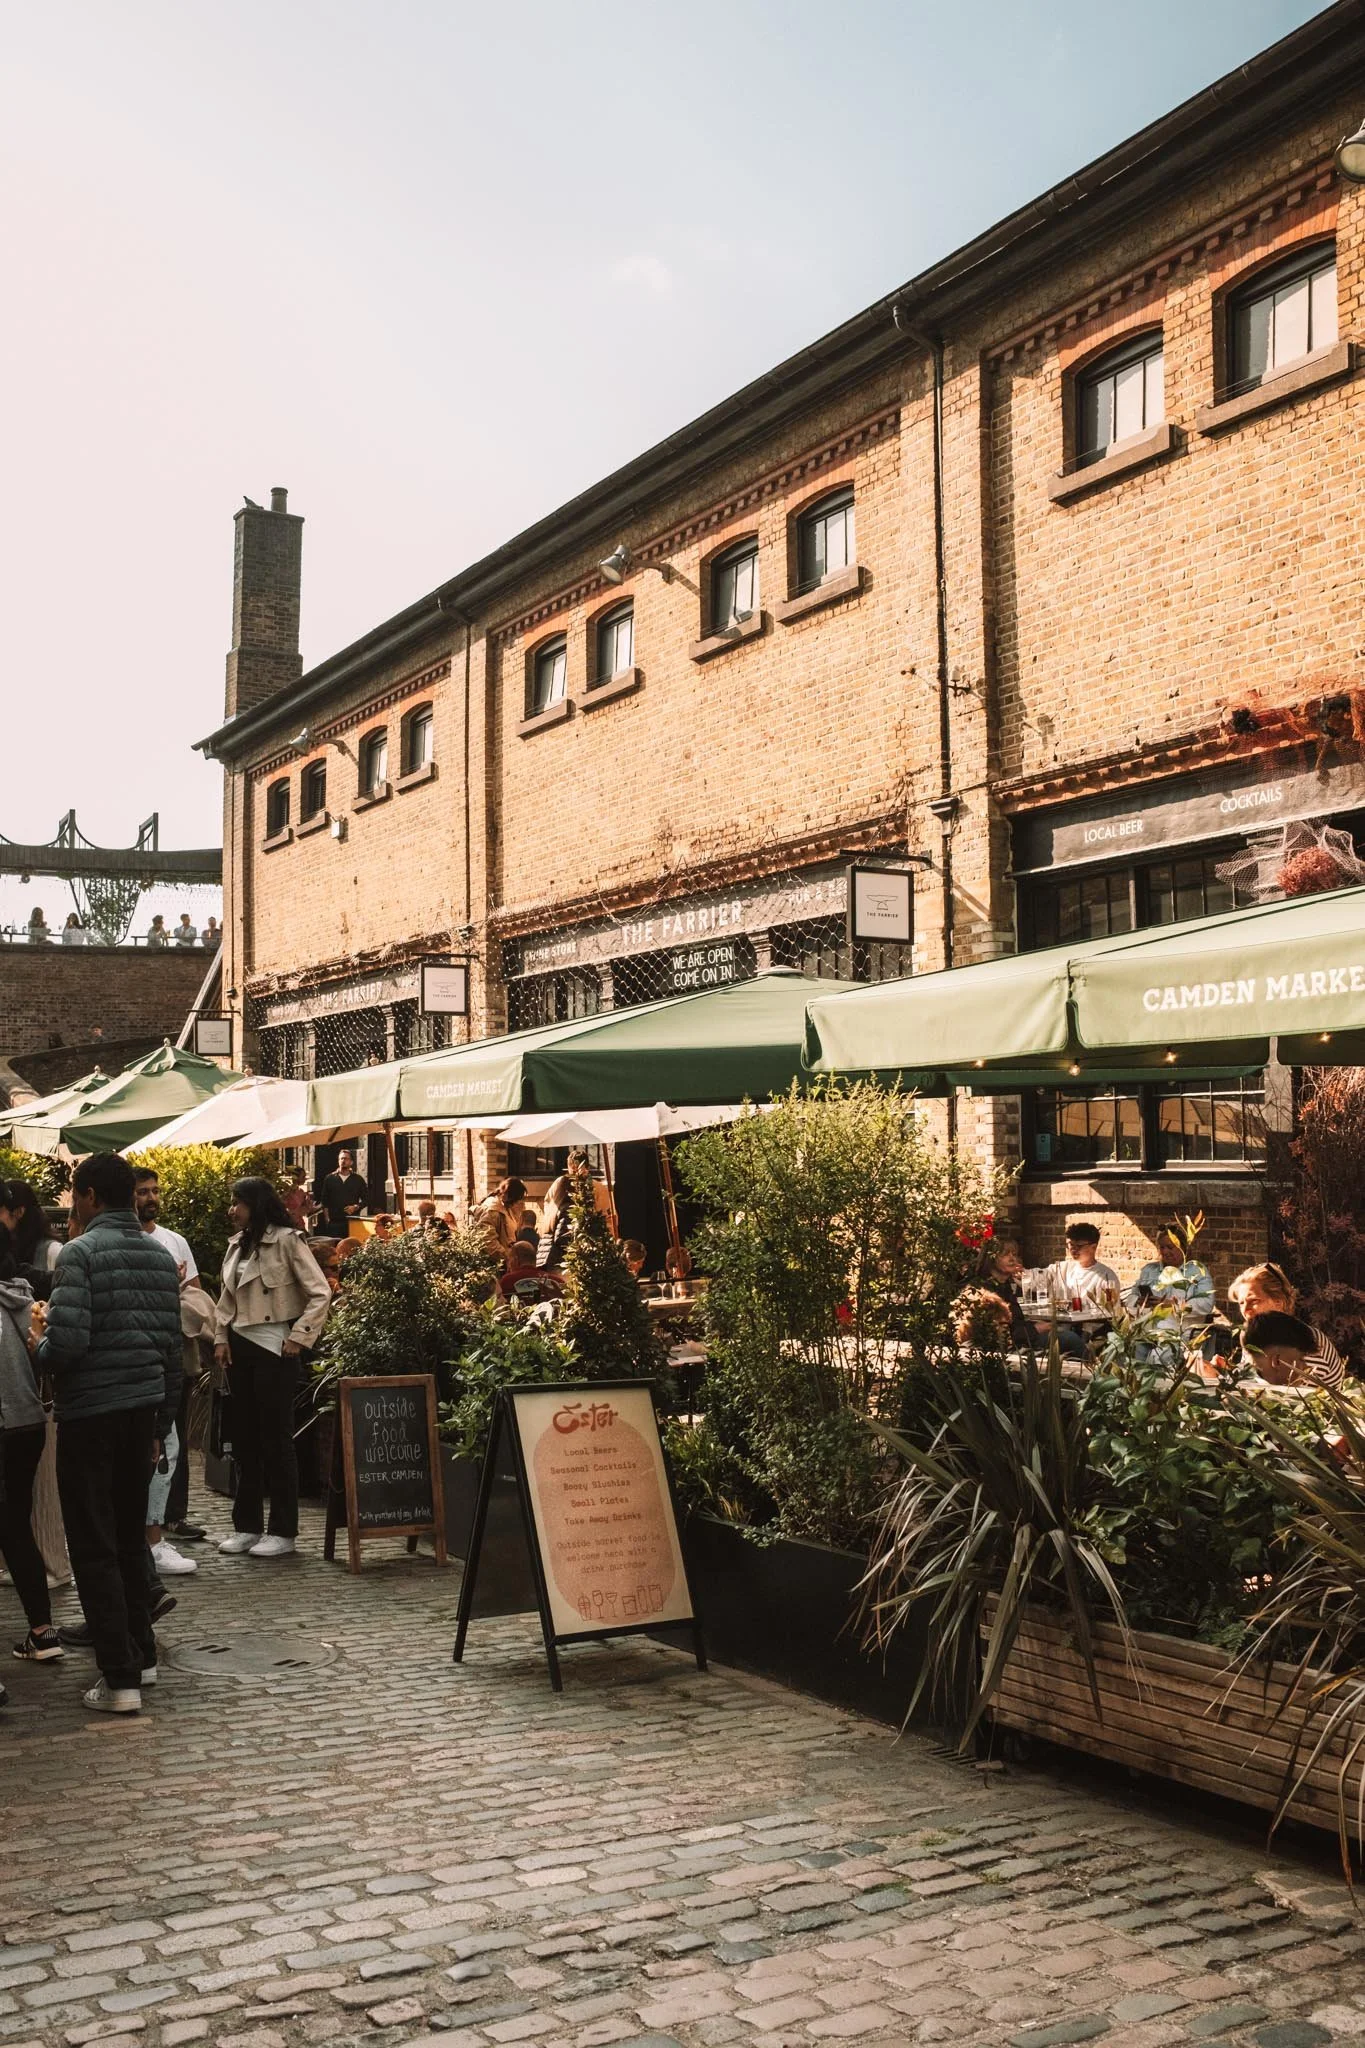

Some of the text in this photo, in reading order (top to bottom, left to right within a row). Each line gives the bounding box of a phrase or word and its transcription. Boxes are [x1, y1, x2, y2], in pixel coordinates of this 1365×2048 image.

[1219, 787, 1283, 814] COCKTAILS
[1084, 819, 1144, 844] LOCAL BEER
[621, 901, 743, 946] THE FARRIER
[551, 941, 577, 956] STORE
[672, 946, 733, 970] WE ARE OPEN
[674, 964, 733, 987] COME ON IN
[1142, 965, 1365, 1012] CAMDEN MARKE
[426, 1079, 502, 1099] CAMDEN MARKET
[365, 1396, 416, 1419] outside
[552, 1402, 619, 1434] Ester
[373, 1421, 408, 1446] food
[366, 1443, 422, 1464] welcome
[564, 1446, 618, 1457] Local Beers
[360, 1470, 423, 1484] ESTER CAMDEN
[550, 1461, 637, 1475] Seasonal Cocktails
[571, 1497, 629, 1508] Small Plates
[564, 1518, 585, 1526] Take
[612, 1513, 642, 1522] Drinks
